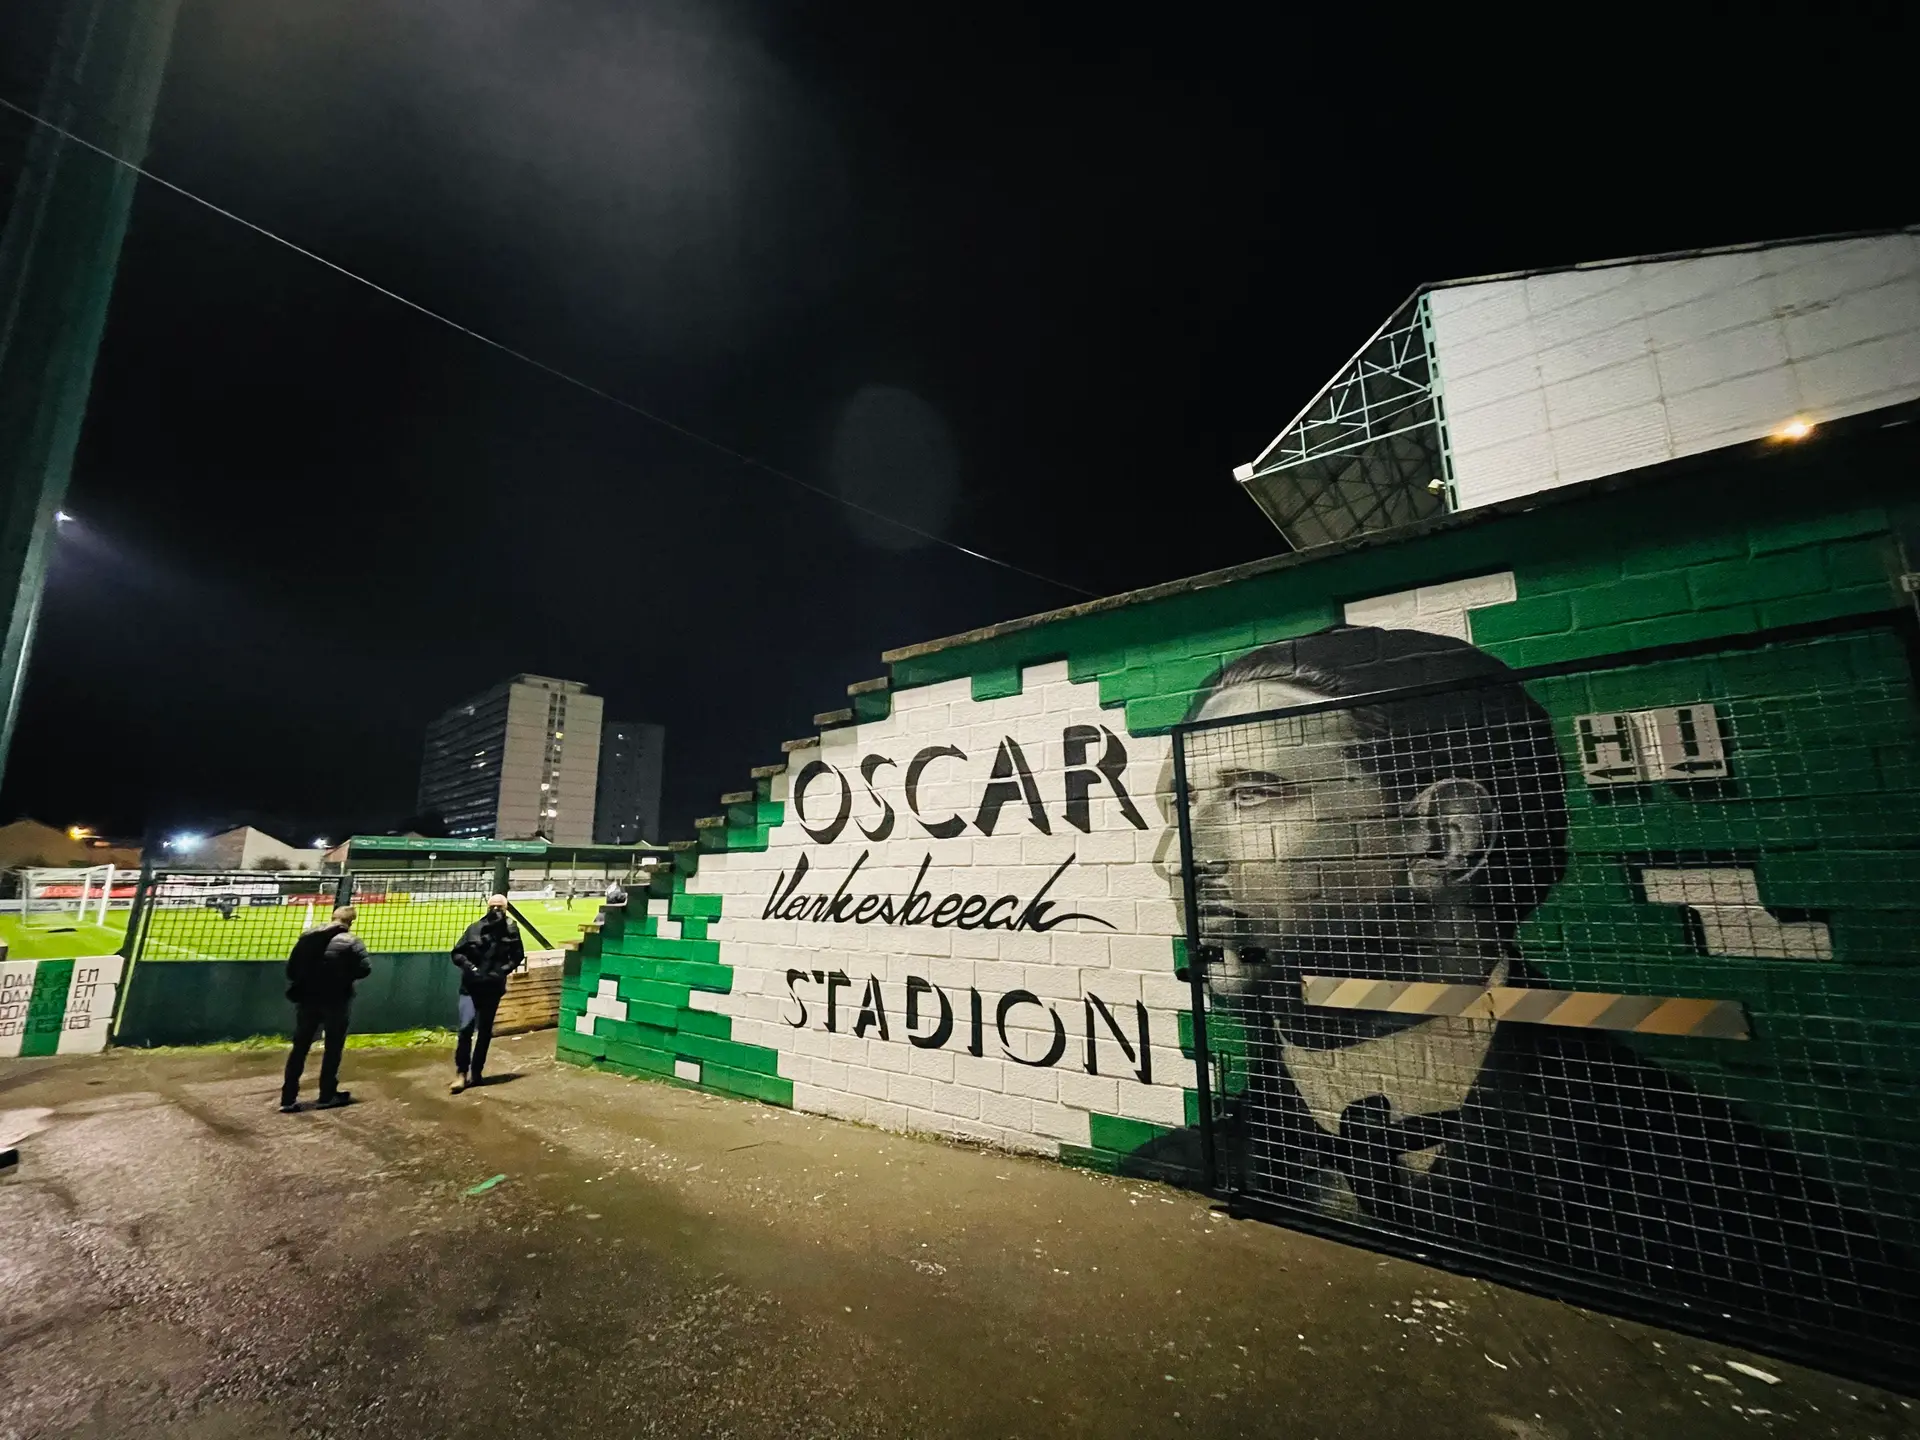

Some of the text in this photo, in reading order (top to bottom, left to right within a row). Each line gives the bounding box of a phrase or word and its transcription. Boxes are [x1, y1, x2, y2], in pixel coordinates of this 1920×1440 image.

[794, 724, 1149, 844] OSCAR
[762, 849, 1118, 932] Vankesbeeck
[74, 984, 97, 998] EM
[77, 968, 99, 983] EM
[783, 968, 1152, 1084] STADION
